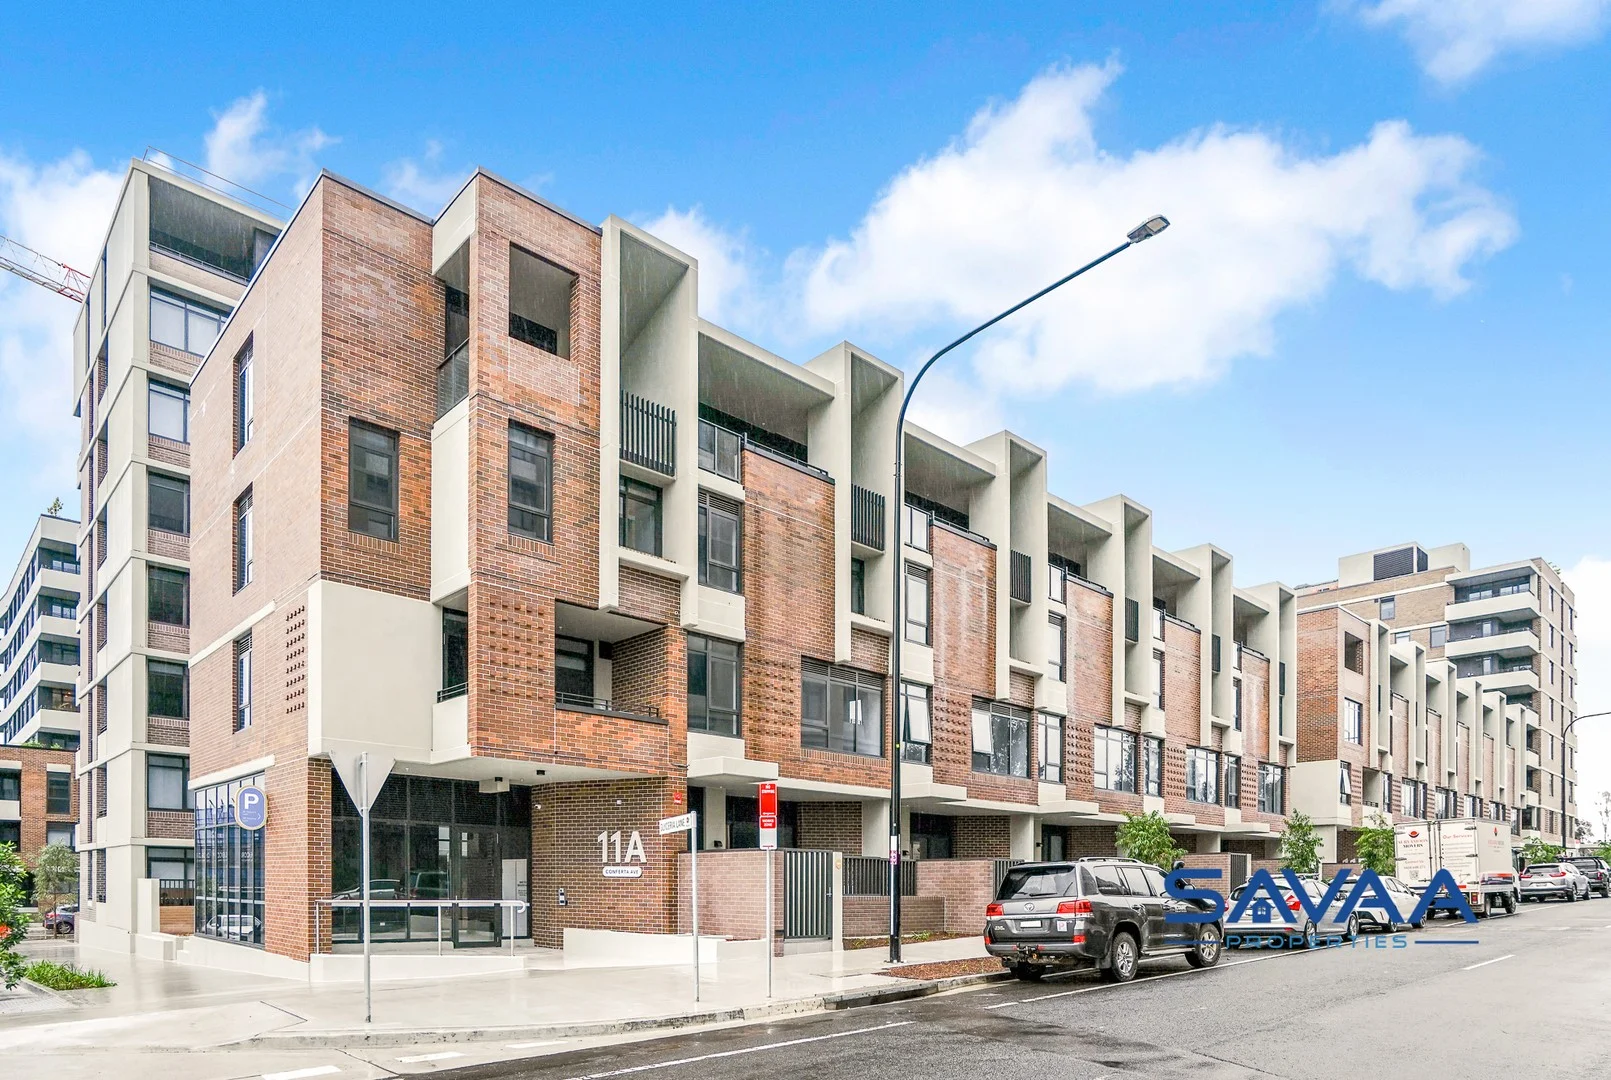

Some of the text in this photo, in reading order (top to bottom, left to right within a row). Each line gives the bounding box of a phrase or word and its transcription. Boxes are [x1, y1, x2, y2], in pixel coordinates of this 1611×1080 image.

[245, 793, 259, 809] P
[676, 817, 685, 828] LANE
[597, 830, 648, 863] 11A
